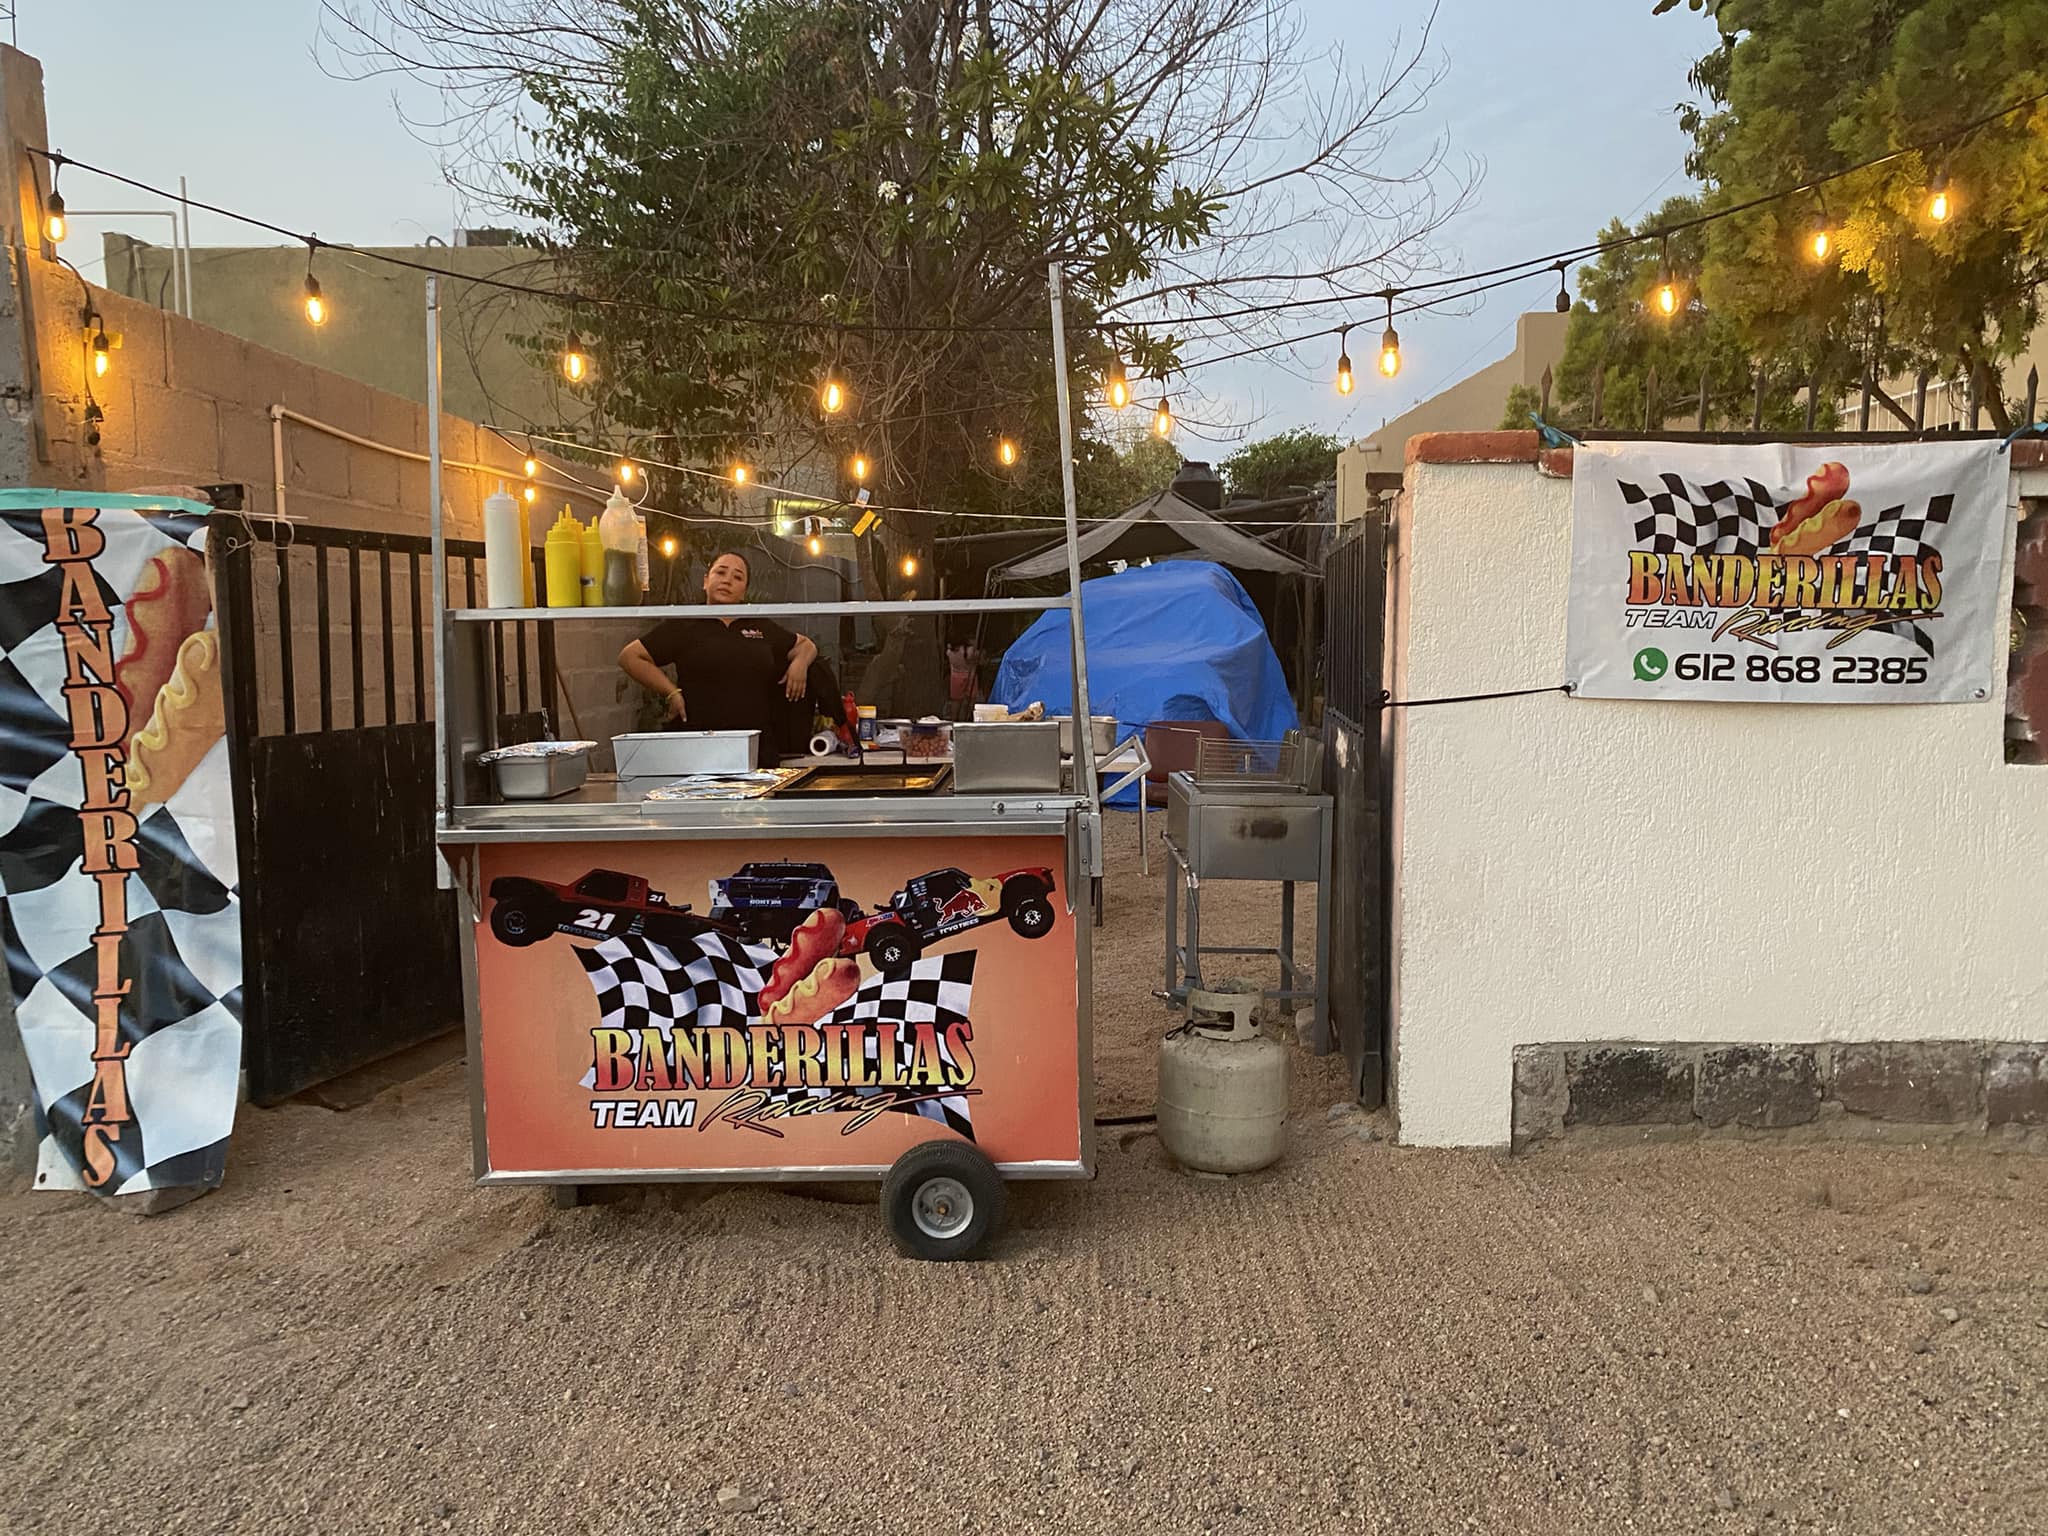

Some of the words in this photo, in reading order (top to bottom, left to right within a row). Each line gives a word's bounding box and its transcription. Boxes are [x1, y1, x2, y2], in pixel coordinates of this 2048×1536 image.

[1626, 551, 1944, 611] BANDERILLAS
[1625, 609, 1717, 629] TEAM
[1711, 607, 1944, 650] Racing
[1674, 653, 1736, 682] 612
[1745, 655, 1821, 684] 868
[1832, 656, 1929, 685] 2385
[41, 507, 141, 1187] BANDERILLAS
[574, 909, 616, 930] 21
[649, 894, 663, 903] 21
[895, 893, 907, 908] 7
[591, 1021, 975, 1092] BANDERILLAS
[591, 1100, 695, 1128] TEAM
[699, 1088, 982, 1138] Racing
